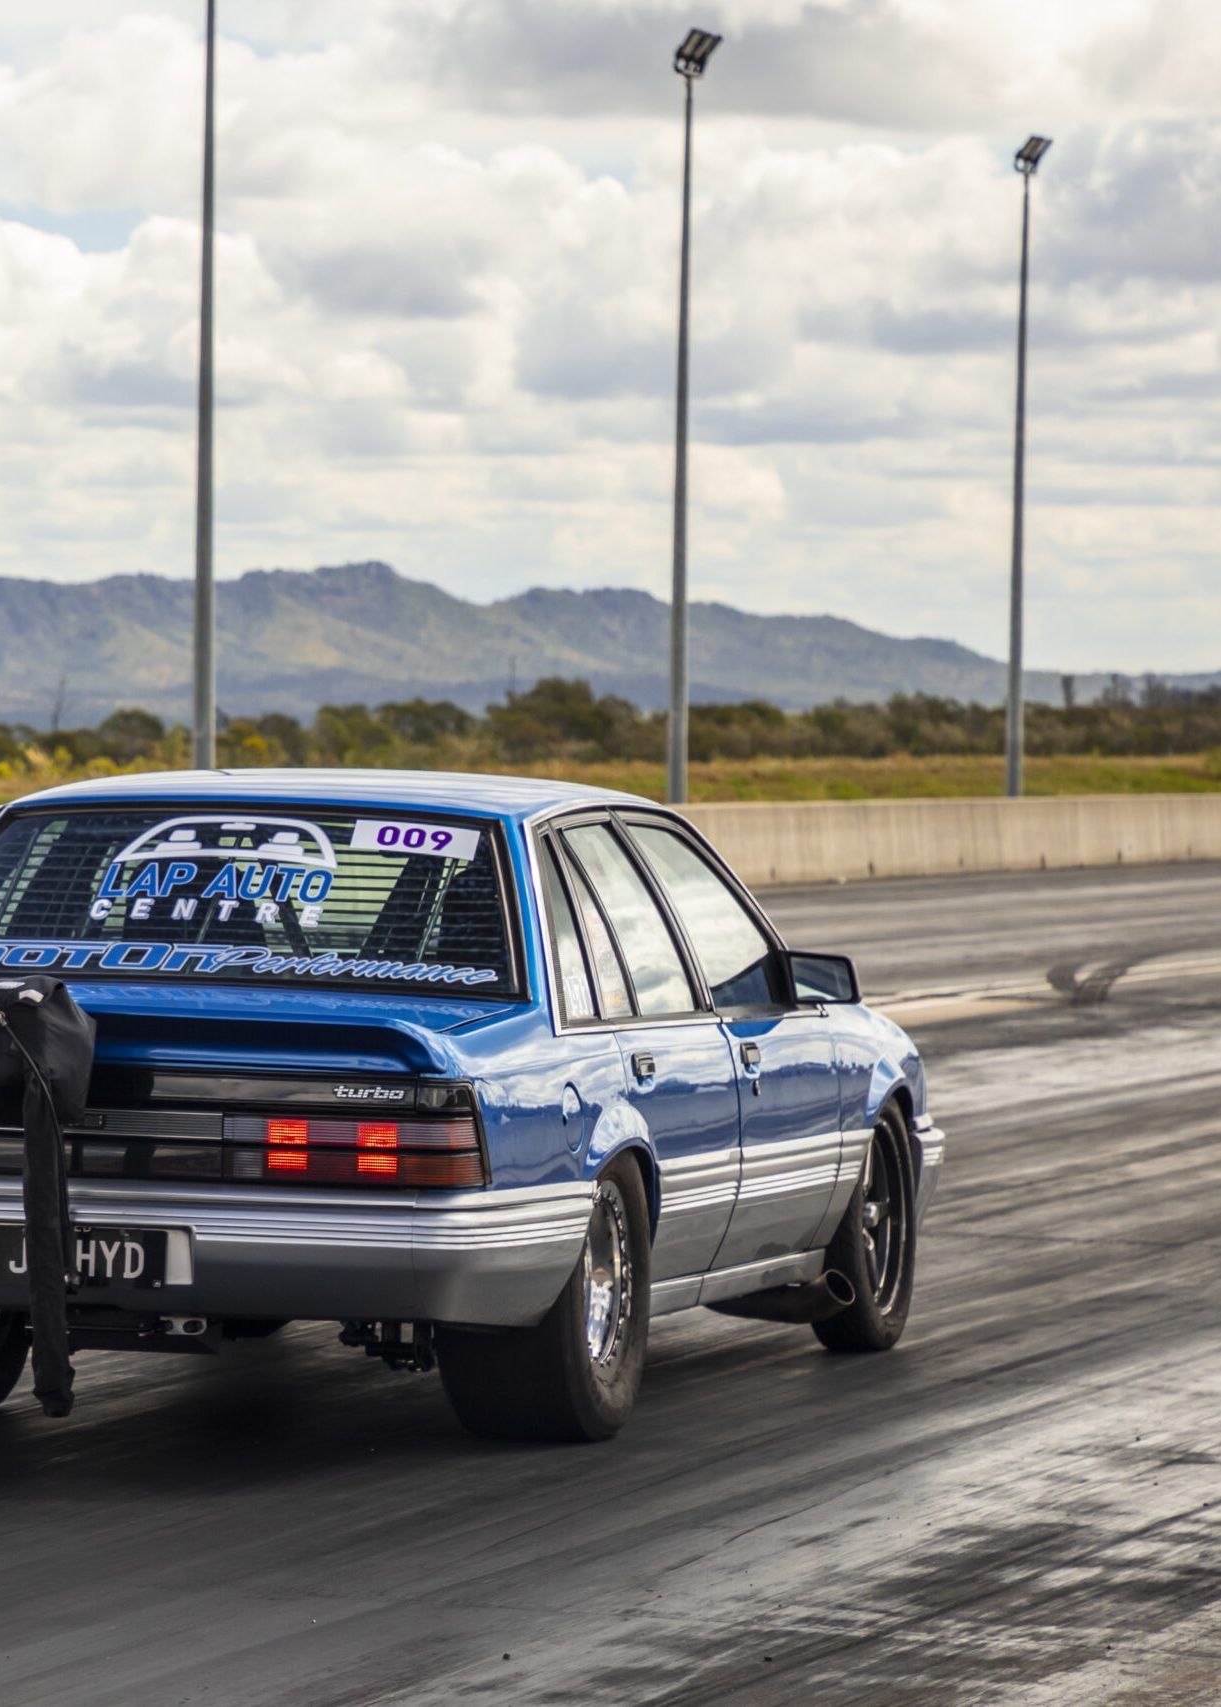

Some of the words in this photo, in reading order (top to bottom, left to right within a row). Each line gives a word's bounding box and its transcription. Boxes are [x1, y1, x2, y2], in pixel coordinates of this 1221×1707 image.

[376, 824, 454, 851] 009
[98, 862, 198, 899] LAP
[201, 862, 336, 905] AUTO
[89, 898, 325, 928] CENTRE
[210, 945, 498, 984] Performance
[333, 1085, 405, 1100] turbo
